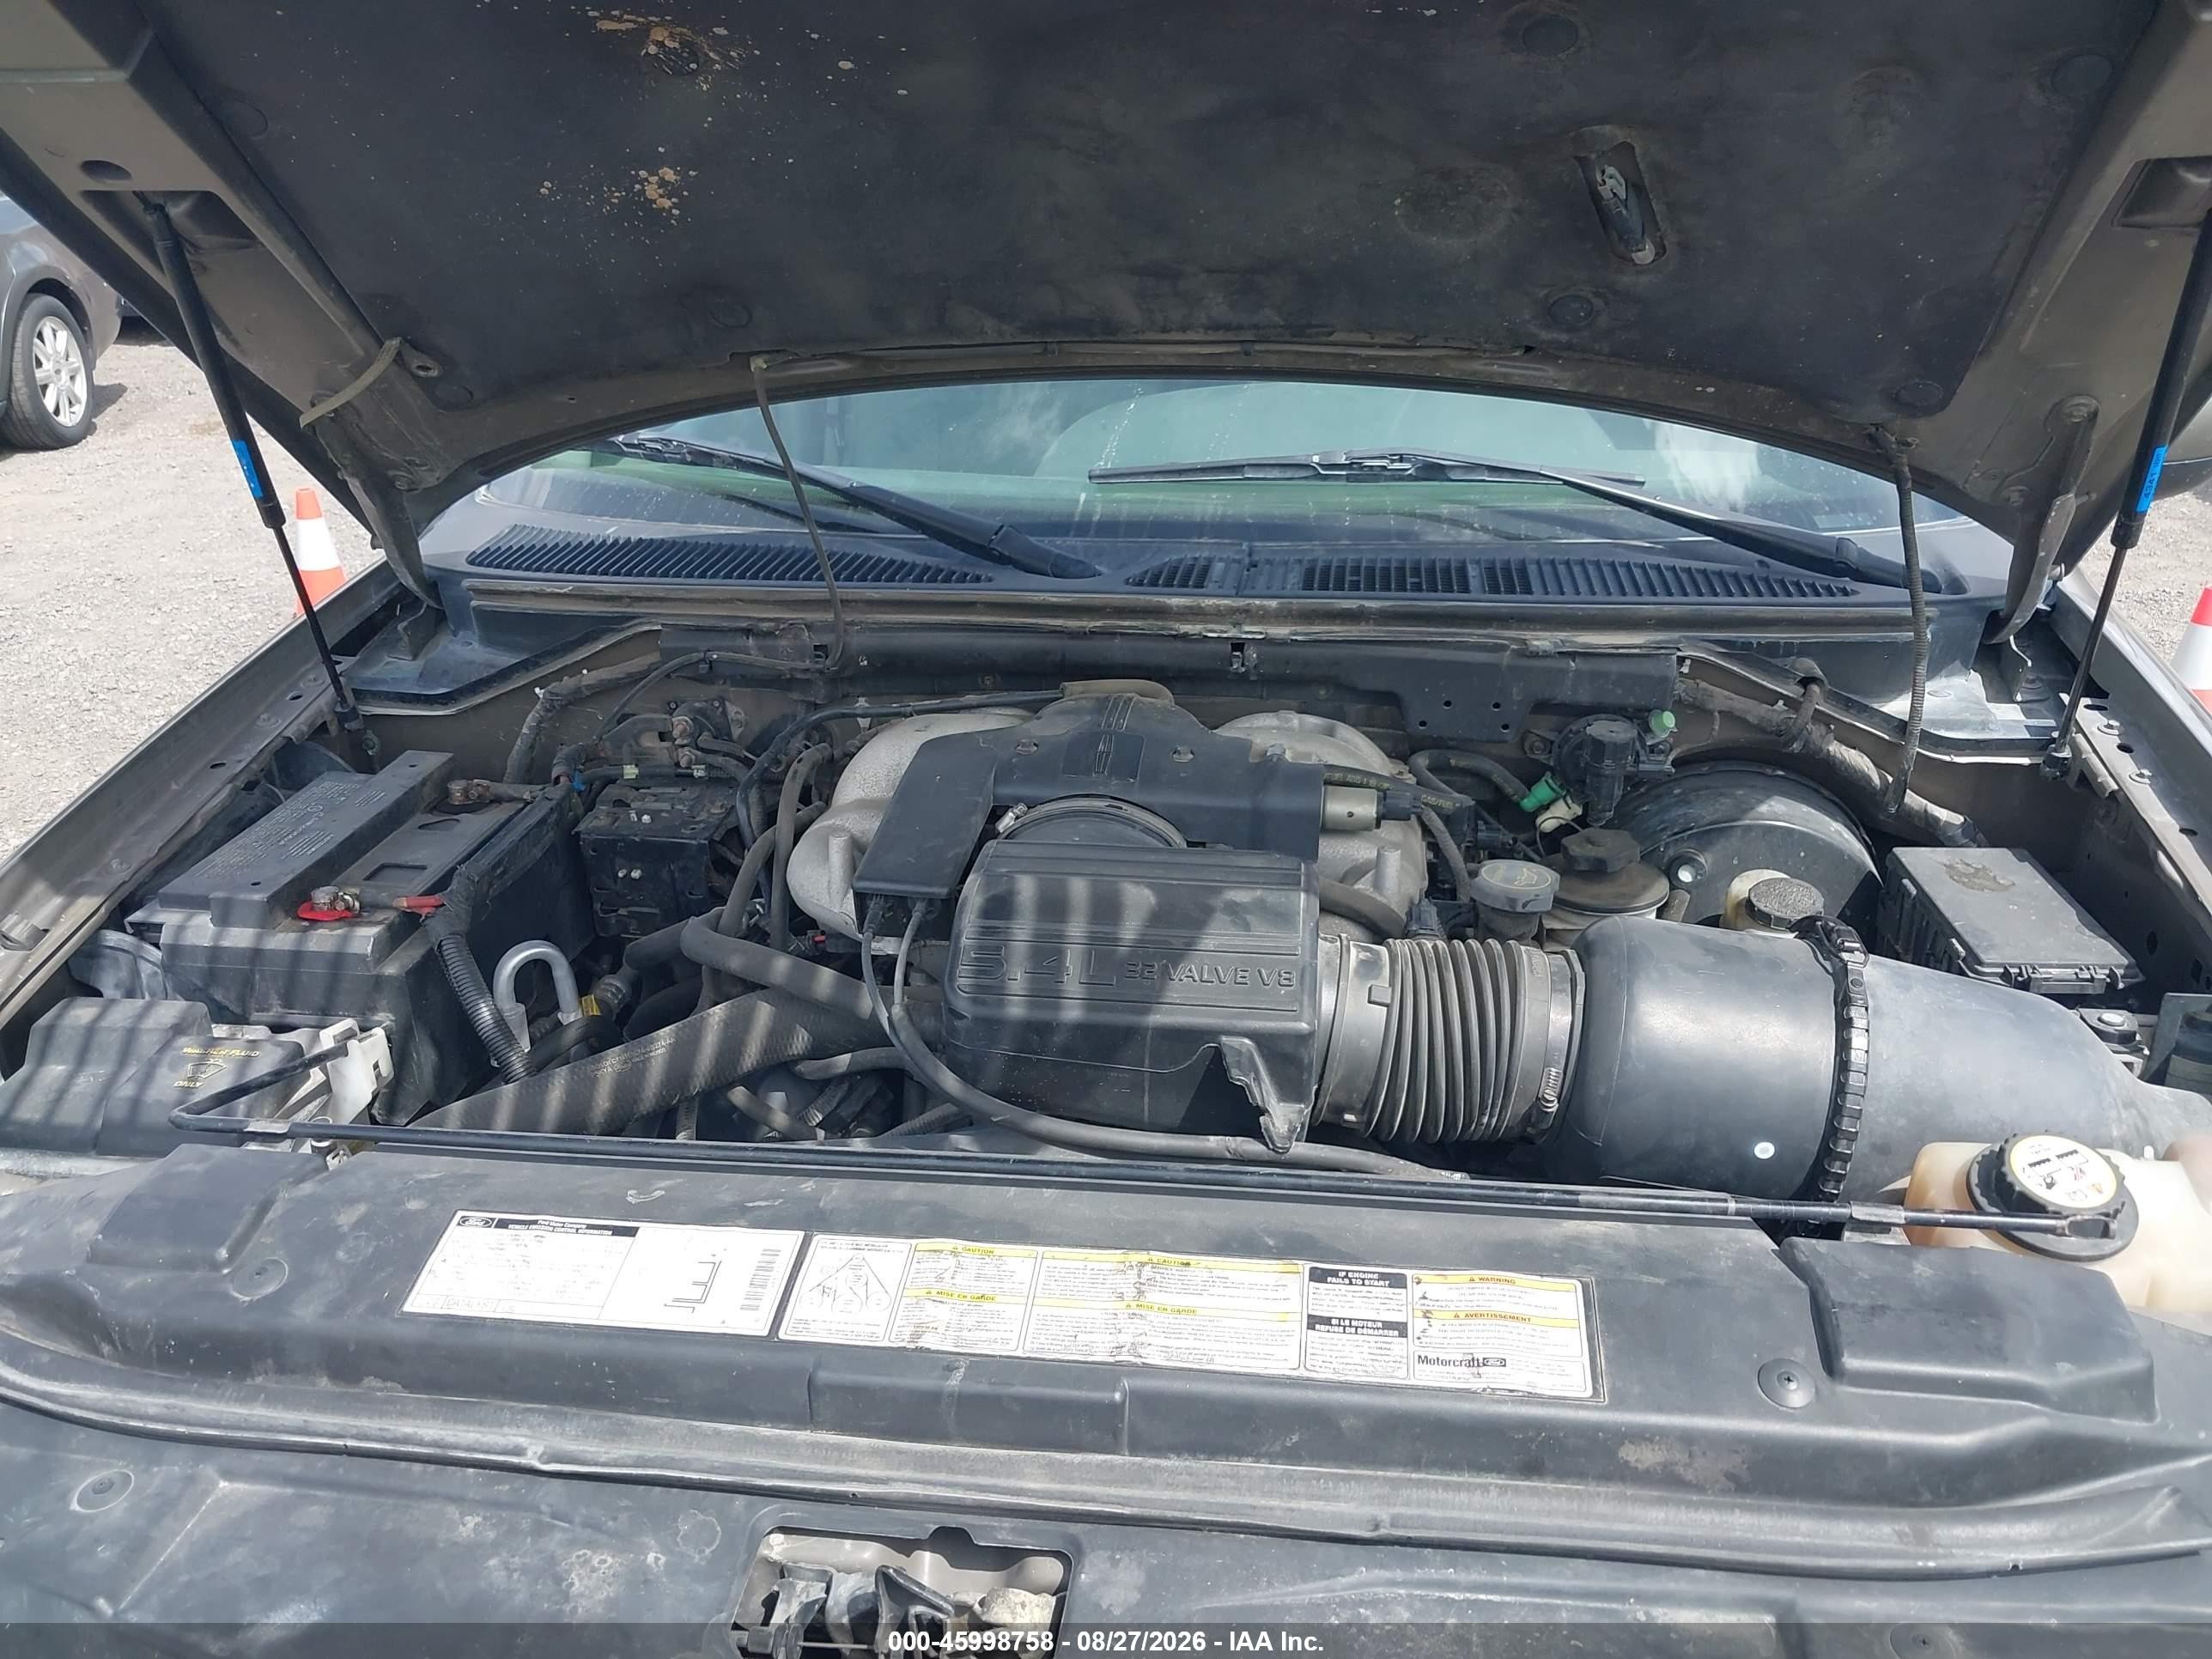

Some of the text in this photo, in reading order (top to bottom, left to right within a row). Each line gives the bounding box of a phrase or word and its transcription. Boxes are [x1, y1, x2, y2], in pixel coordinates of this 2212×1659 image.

[957, 945, 1116, 986] 5.4L
[1124, 960, 1296, 988] 32 VALVE V8
[229, 1049, 261, 1058] FLUID
[173, 1080, 205, 1089] ONLY
[1347, 1271, 1379, 1279] ENGINE
[1364, 1279, 1390, 1287] START
[1464, 1312, 1531, 1322] AVERTISSEMENT
[1351, 1320, 1382, 1328] MOTEUR
[1417, 1354, 1481, 1368] Motorcraft
